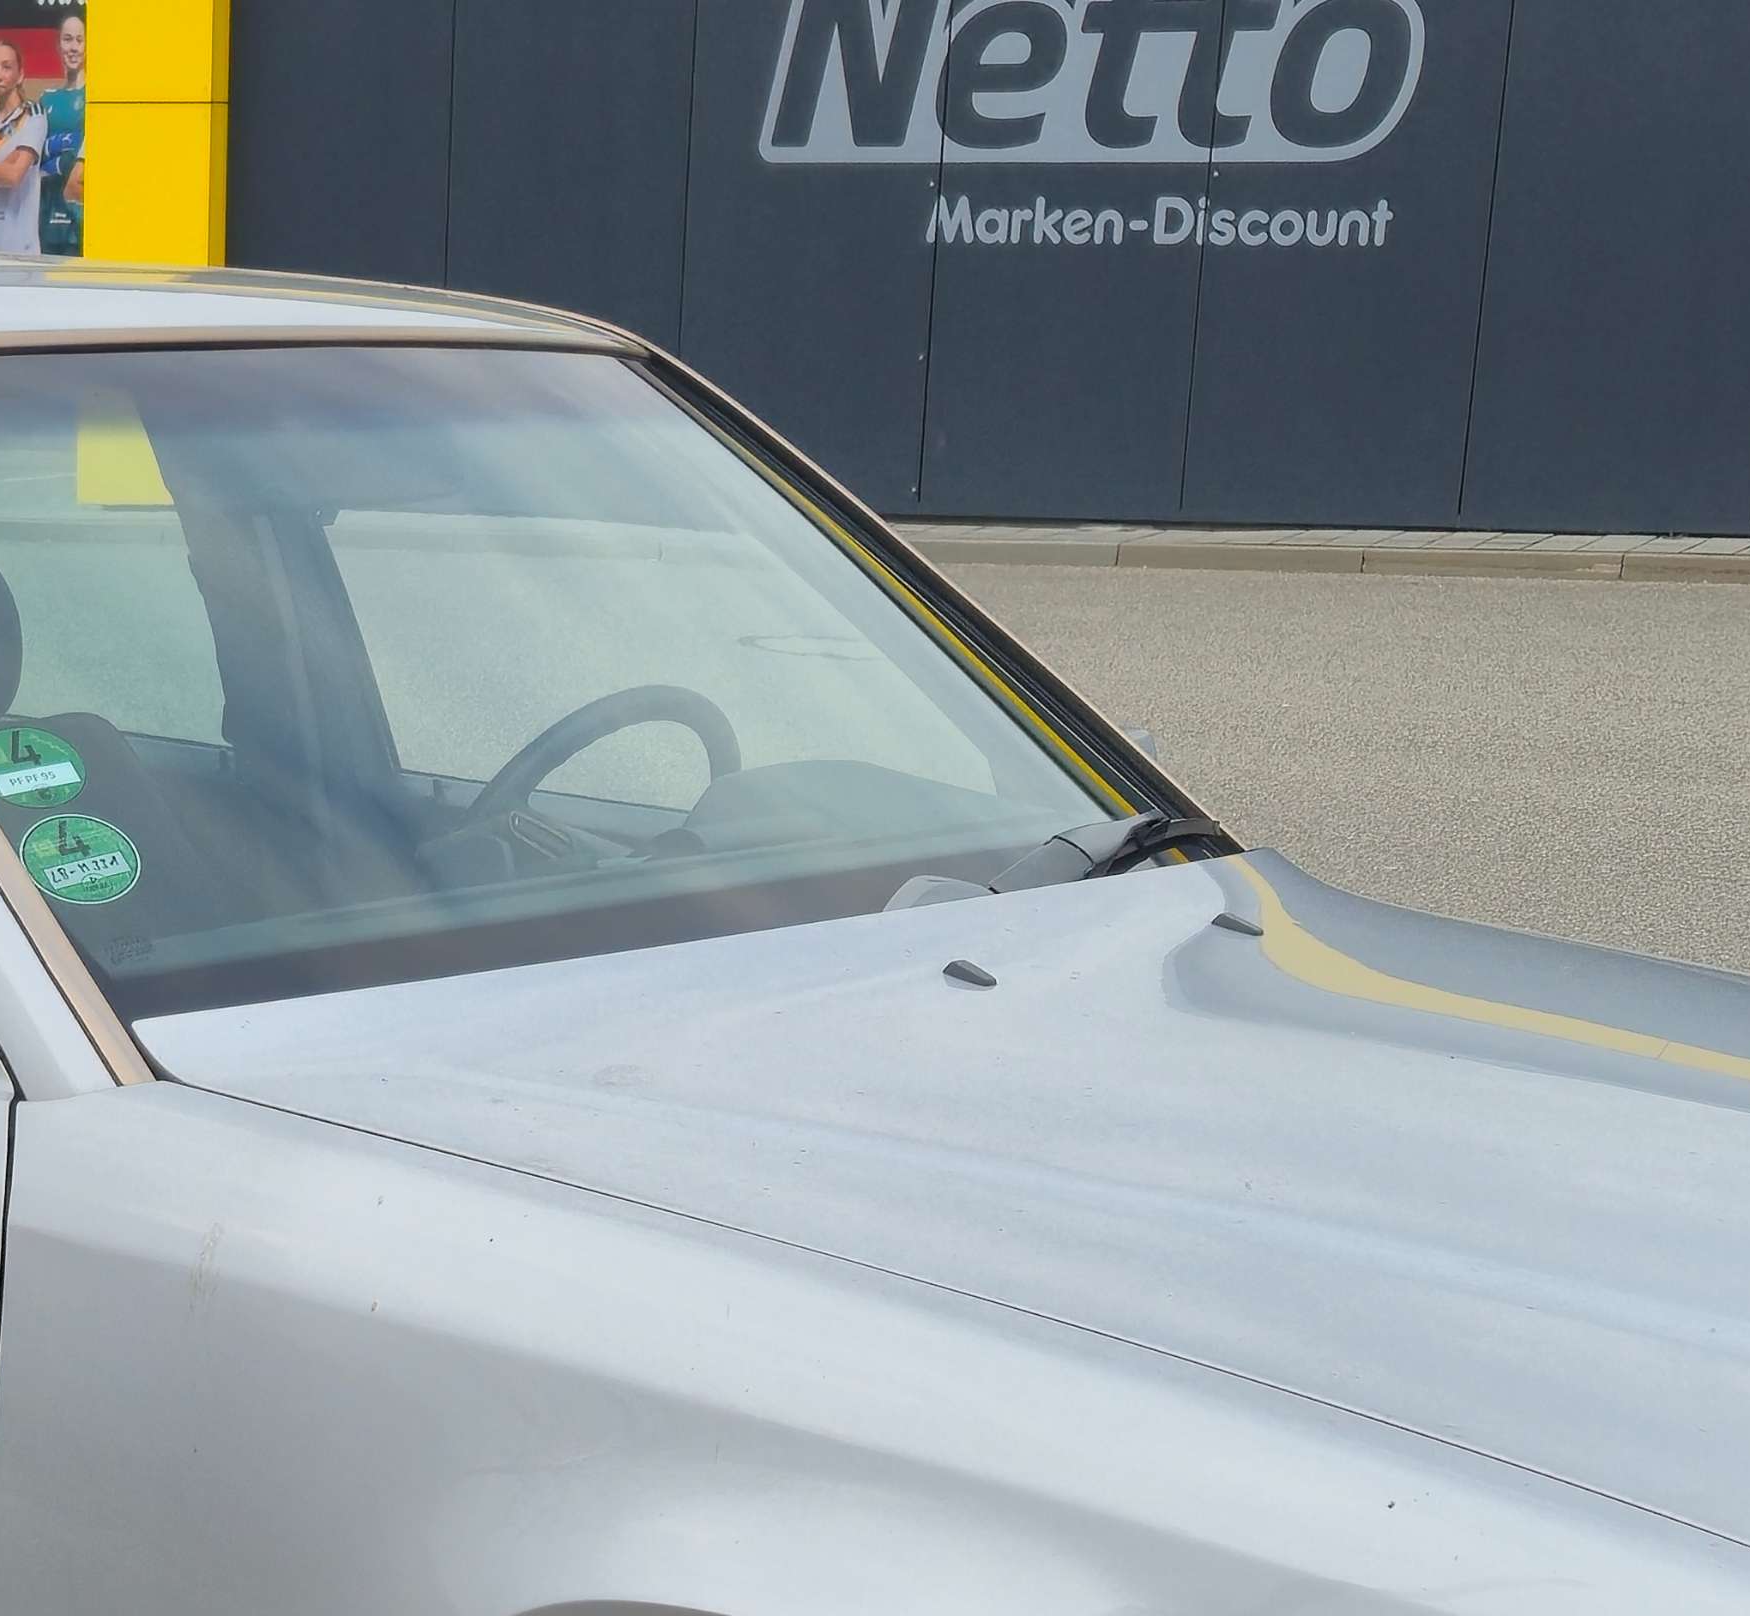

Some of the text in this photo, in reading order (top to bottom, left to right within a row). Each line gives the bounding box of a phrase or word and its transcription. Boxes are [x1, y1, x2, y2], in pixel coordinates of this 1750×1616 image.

[768, 0, 1416, 151] Netto
[926, 195, 1393, 247] Marken-Discount
[11, 730, 41, 766] 4
[58, 820, 91, 857] 4
